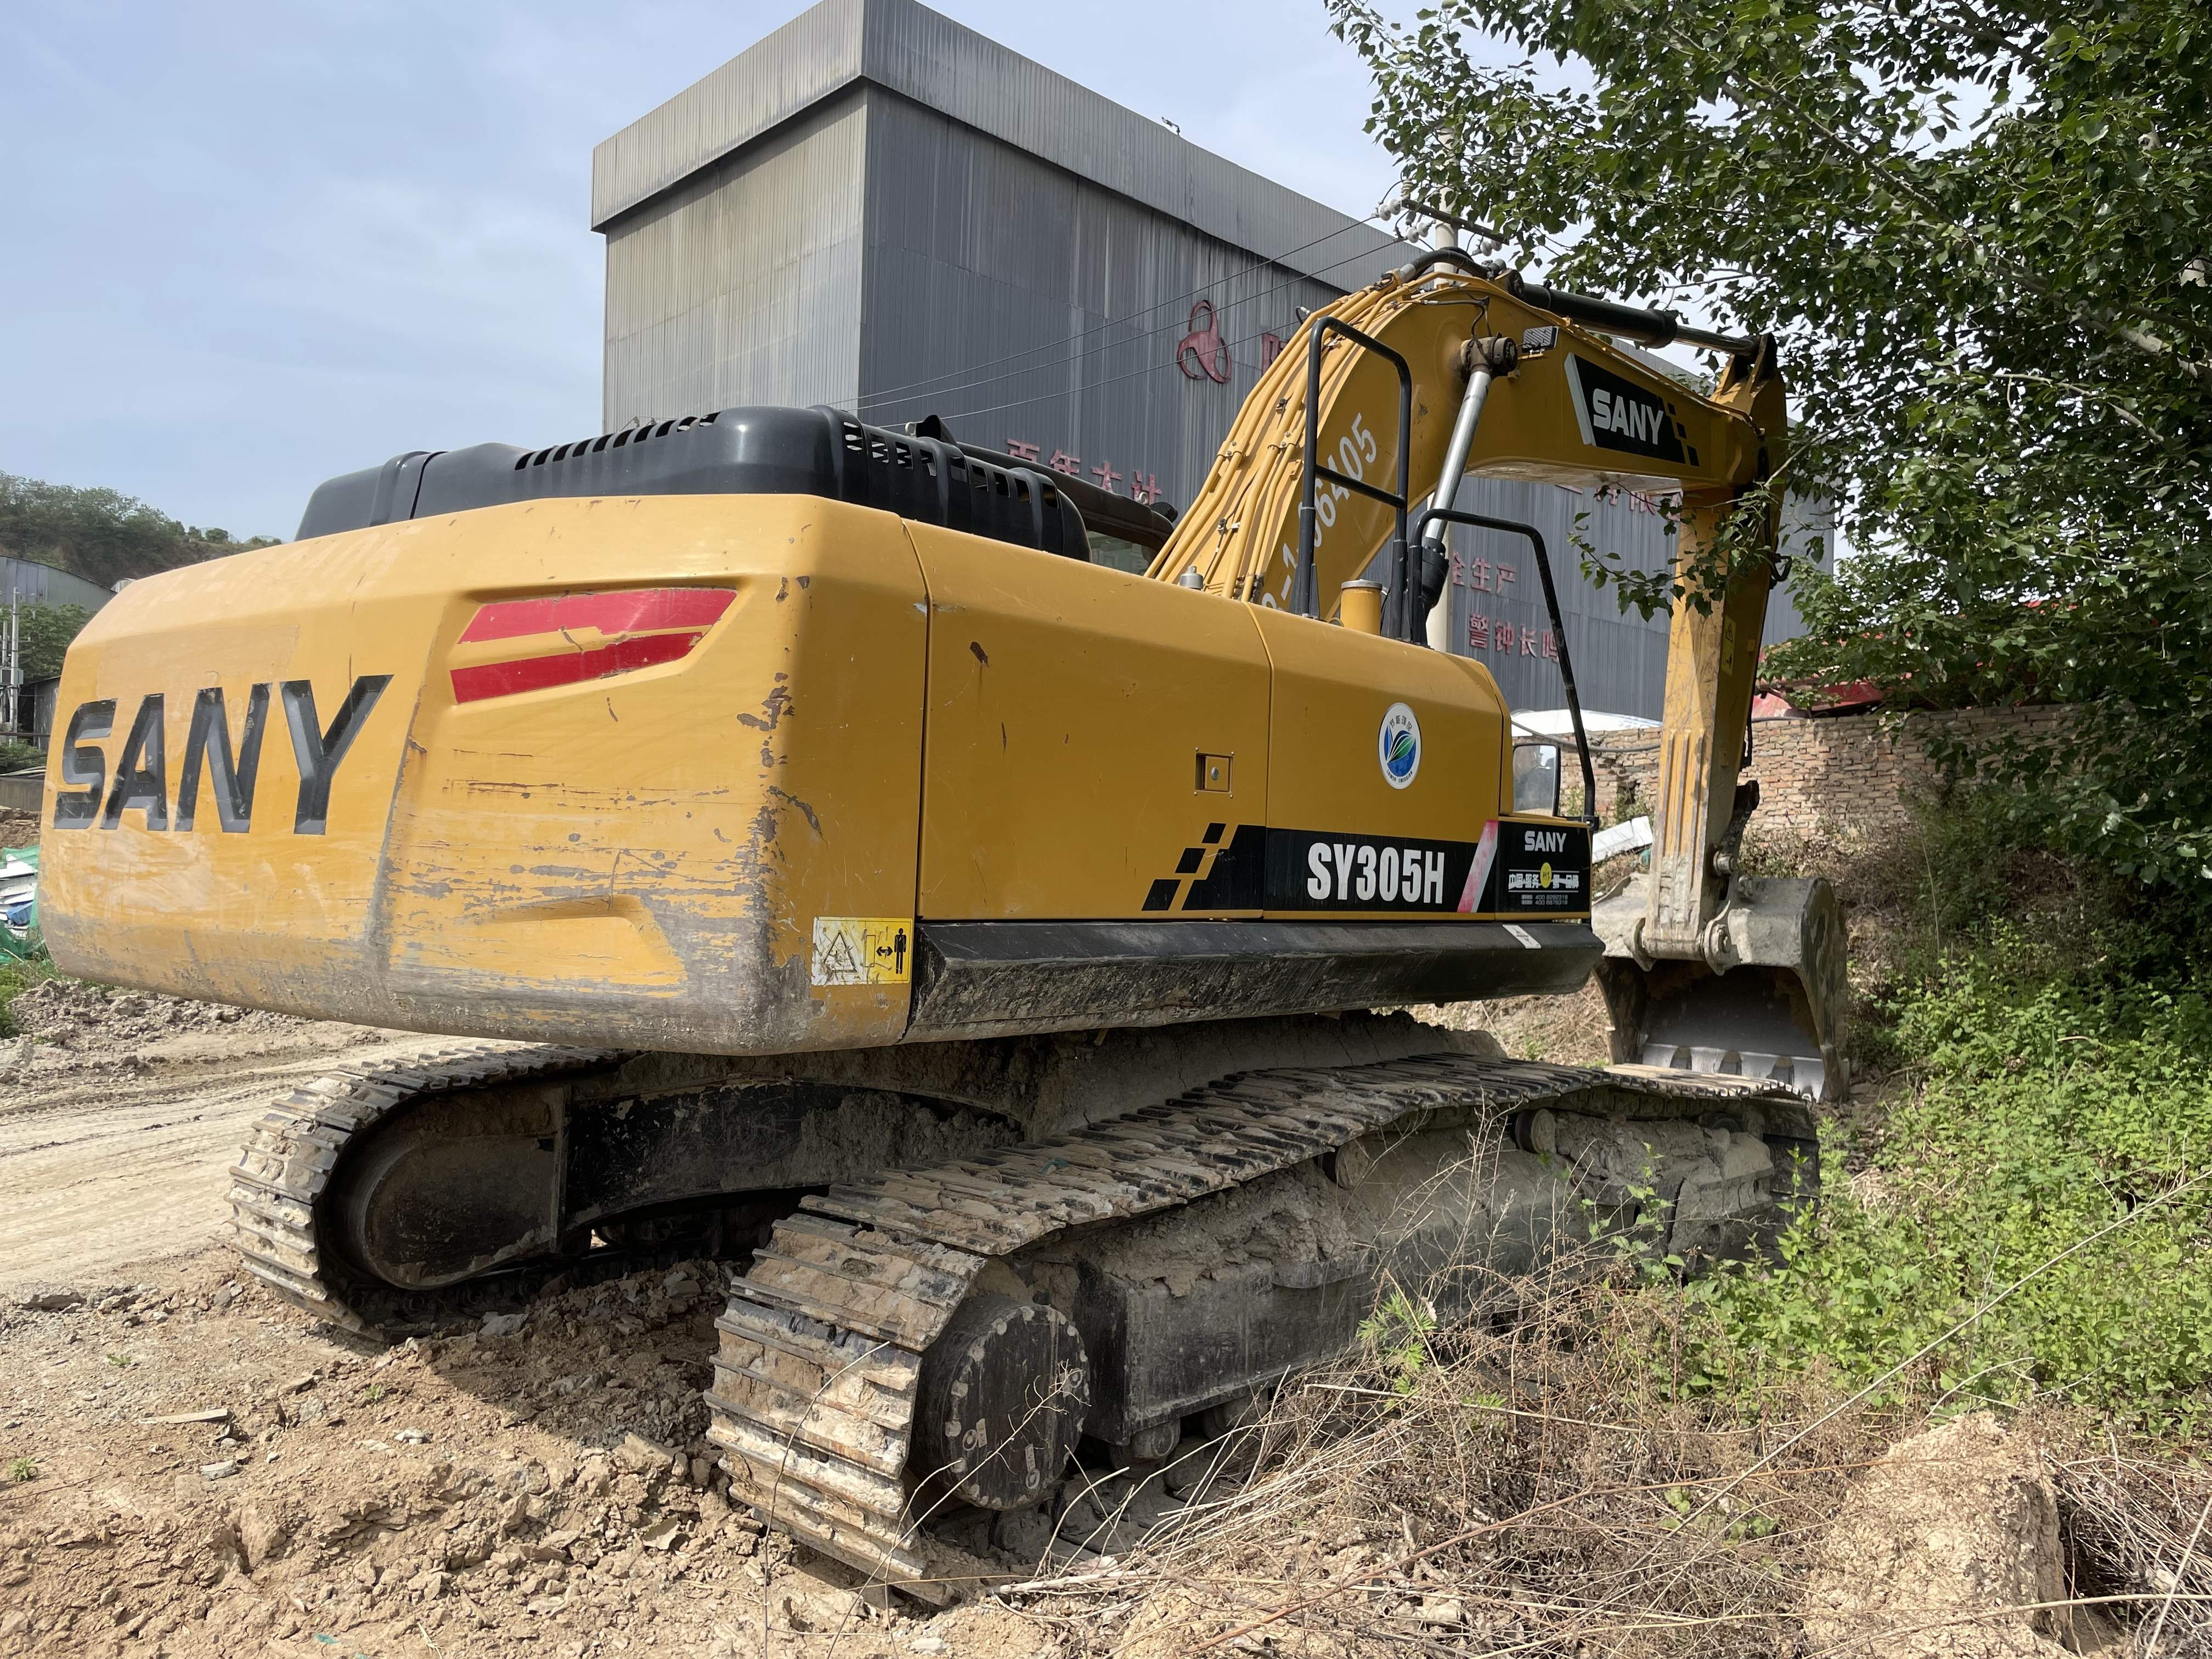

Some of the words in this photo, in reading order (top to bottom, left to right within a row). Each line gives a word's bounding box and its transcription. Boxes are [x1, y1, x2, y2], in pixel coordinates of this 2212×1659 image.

[1593, 388, 1664, 445] SANY
[53, 674, 394, 835] SANY
[1525, 830, 1567, 852] SANY
[1307, 842, 1444, 904] SY305H
